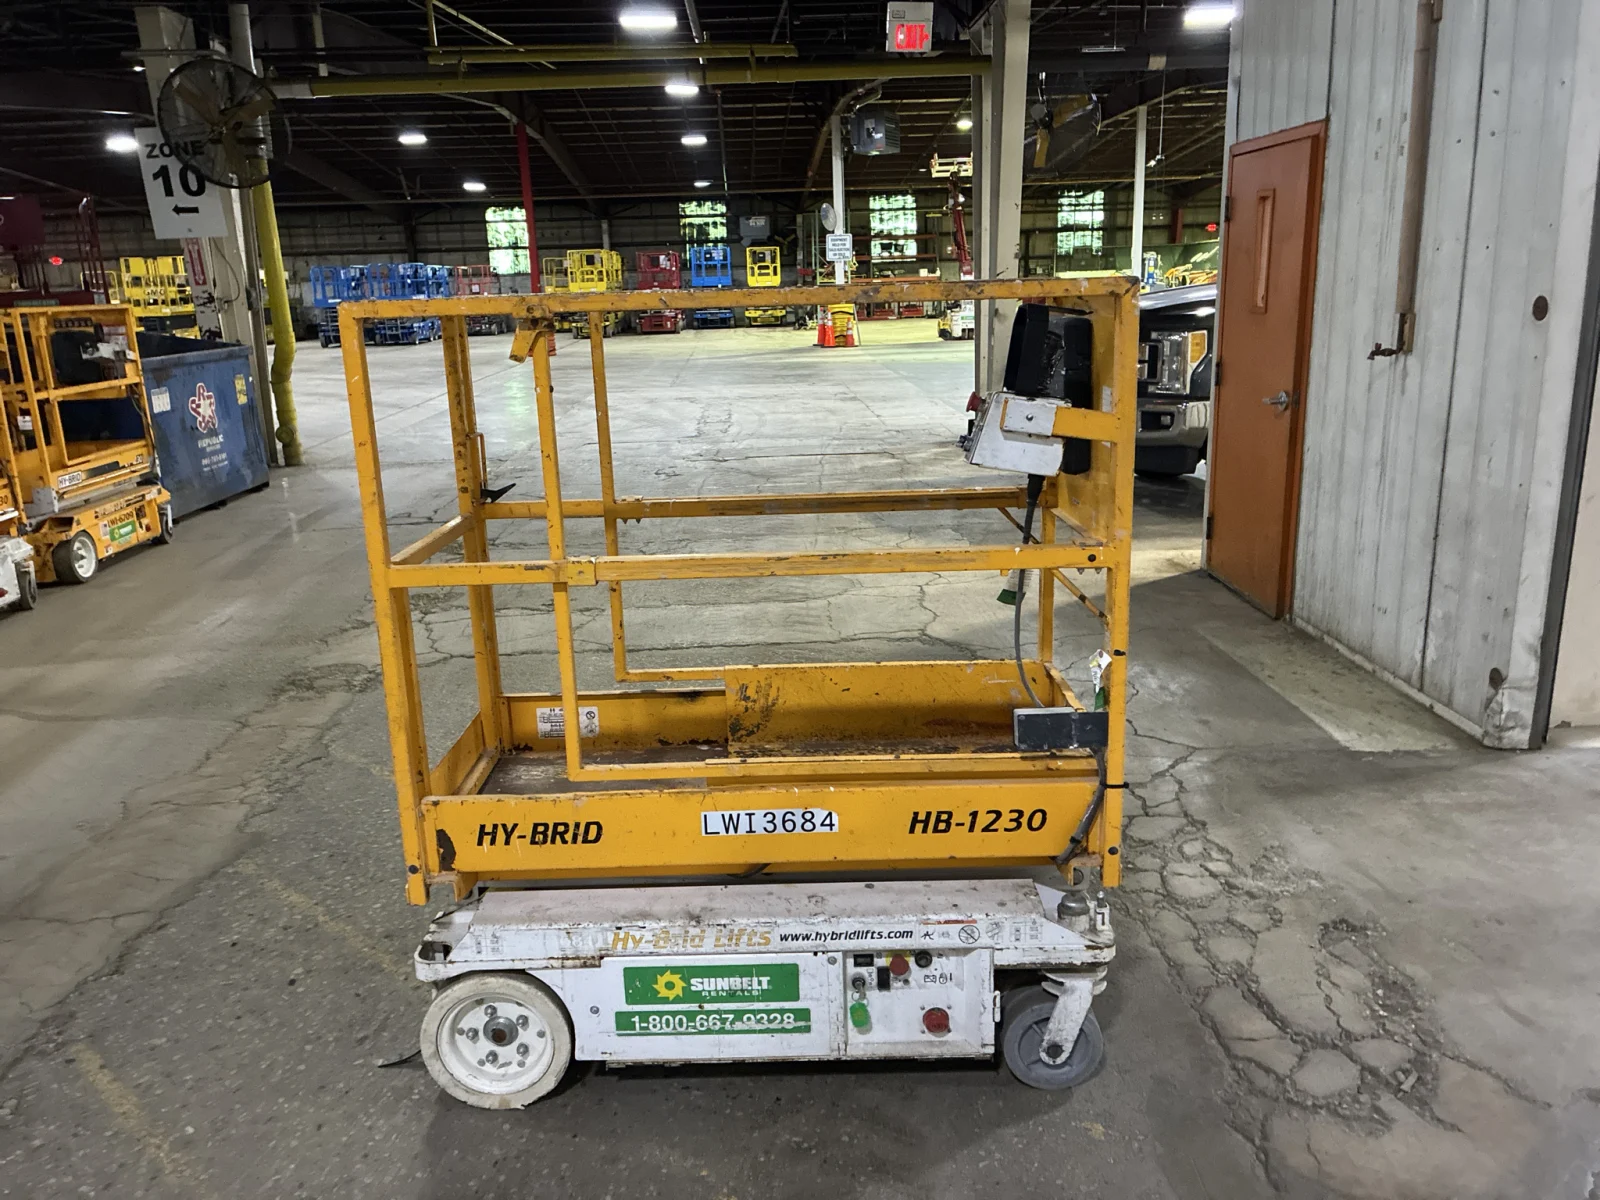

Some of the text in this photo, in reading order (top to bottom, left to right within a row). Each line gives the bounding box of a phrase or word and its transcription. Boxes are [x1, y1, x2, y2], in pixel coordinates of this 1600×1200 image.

[144, 140, 205, 159] ZONE
[152, 164, 206, 198] 10
[58, 472, 82, 488] HY-BRID
[703, 810, 836, 836] LWI3684
[908, 808, 1048, 835] HB-1230
[476, 820, 604, 847] HY-BRID
[611, 927, 772, 951] Hy-Bid Lifts
[779, 929, 914, 943] www.hybridlifts.com
[690, 976, 771, 992] SUNBELT
[631, 1012, 796, 1034] 1-800-667-9328
